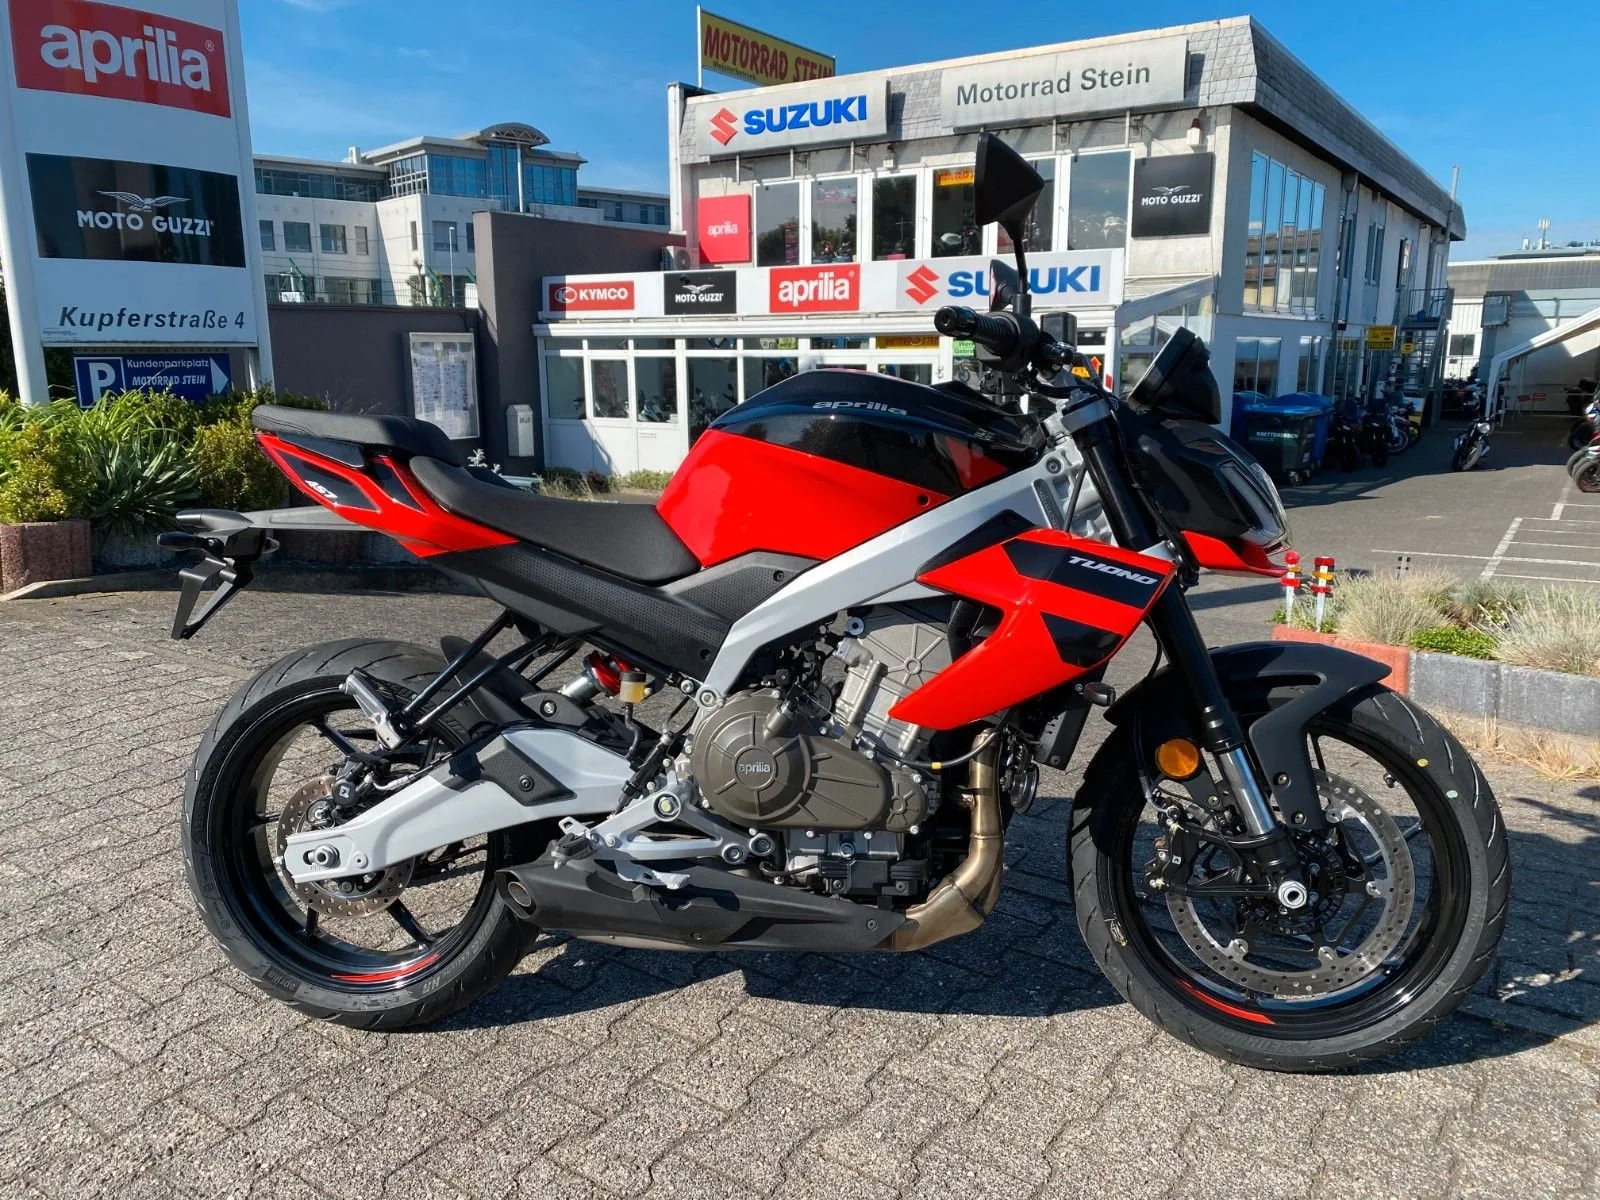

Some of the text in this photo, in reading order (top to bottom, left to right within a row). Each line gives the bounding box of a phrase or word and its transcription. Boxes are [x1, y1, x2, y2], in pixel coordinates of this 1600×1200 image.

[40, 24, 211, 91] aprilia
[704, 24, 789, 81] MOTORRAD
[957, 62, 1150, 106] Motorrad Stein
[744, 95, 867, 135] SUZUKI
[1141, 193, 1200, 206] MOTO GUZZI
[77, 210, 211, 236] MOTO GUZZI
[707, 221, 739, 238] aprilia
[580, 287, 629, 301] KYMCO
[778, 271, 849, 307] aprilia
[947, 265, 1100, 297] SUUKI
[675, 292, 722, 303] MOTO GUZZI
[59, 306, 245, 332] Kupferstraße 4
[127, 359, 209, 369] Kundenparkplatz
[88, 362, 116, 408] P
[132, 375, 206, 386] MOTORRAD STEIN
[812, 401, 907, 416] aprilia
[304, 480, 338, 499] 457
[1066, 556, 1159, 586] TUONO
[738, 762, 771, 775] aprilia
